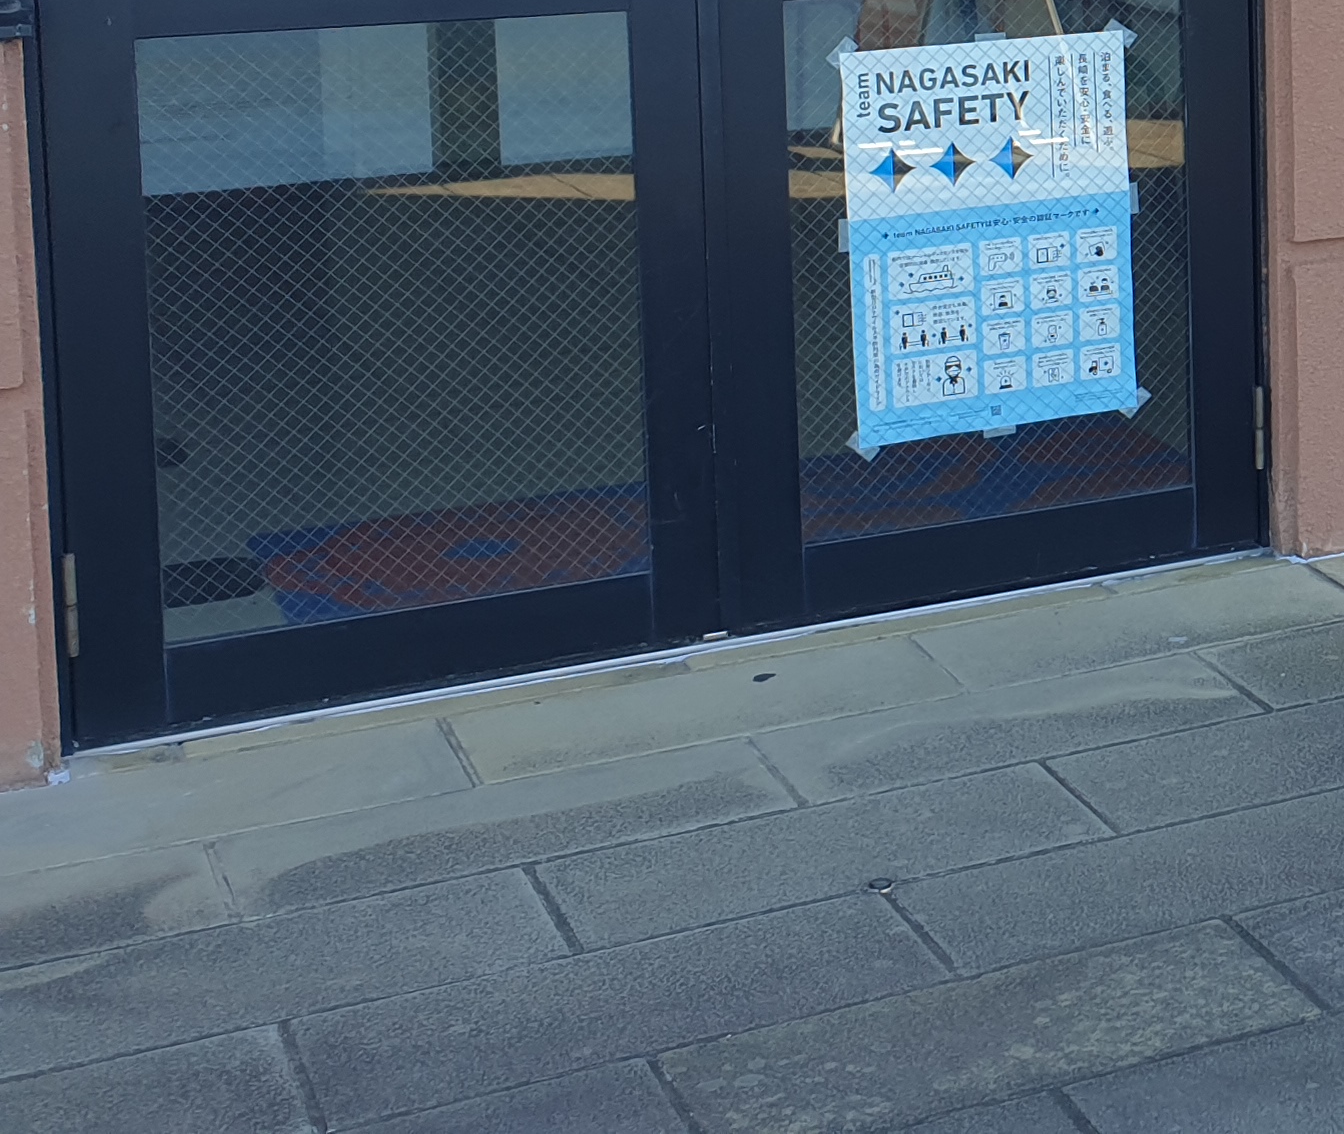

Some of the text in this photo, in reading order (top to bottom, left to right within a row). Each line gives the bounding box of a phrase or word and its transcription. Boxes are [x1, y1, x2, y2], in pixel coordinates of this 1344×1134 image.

[857, 72, 871, 118] team
[876, 59, 1031, 95] NAGASAKI
[877, 90, 1031, 133] SAFETY
[1100, 52, 1115, 151] 泊まる、食べる、遊ぶ。
[893, 231, 913, 239] team
[914, 225, 955, 237] NAGASAKI
